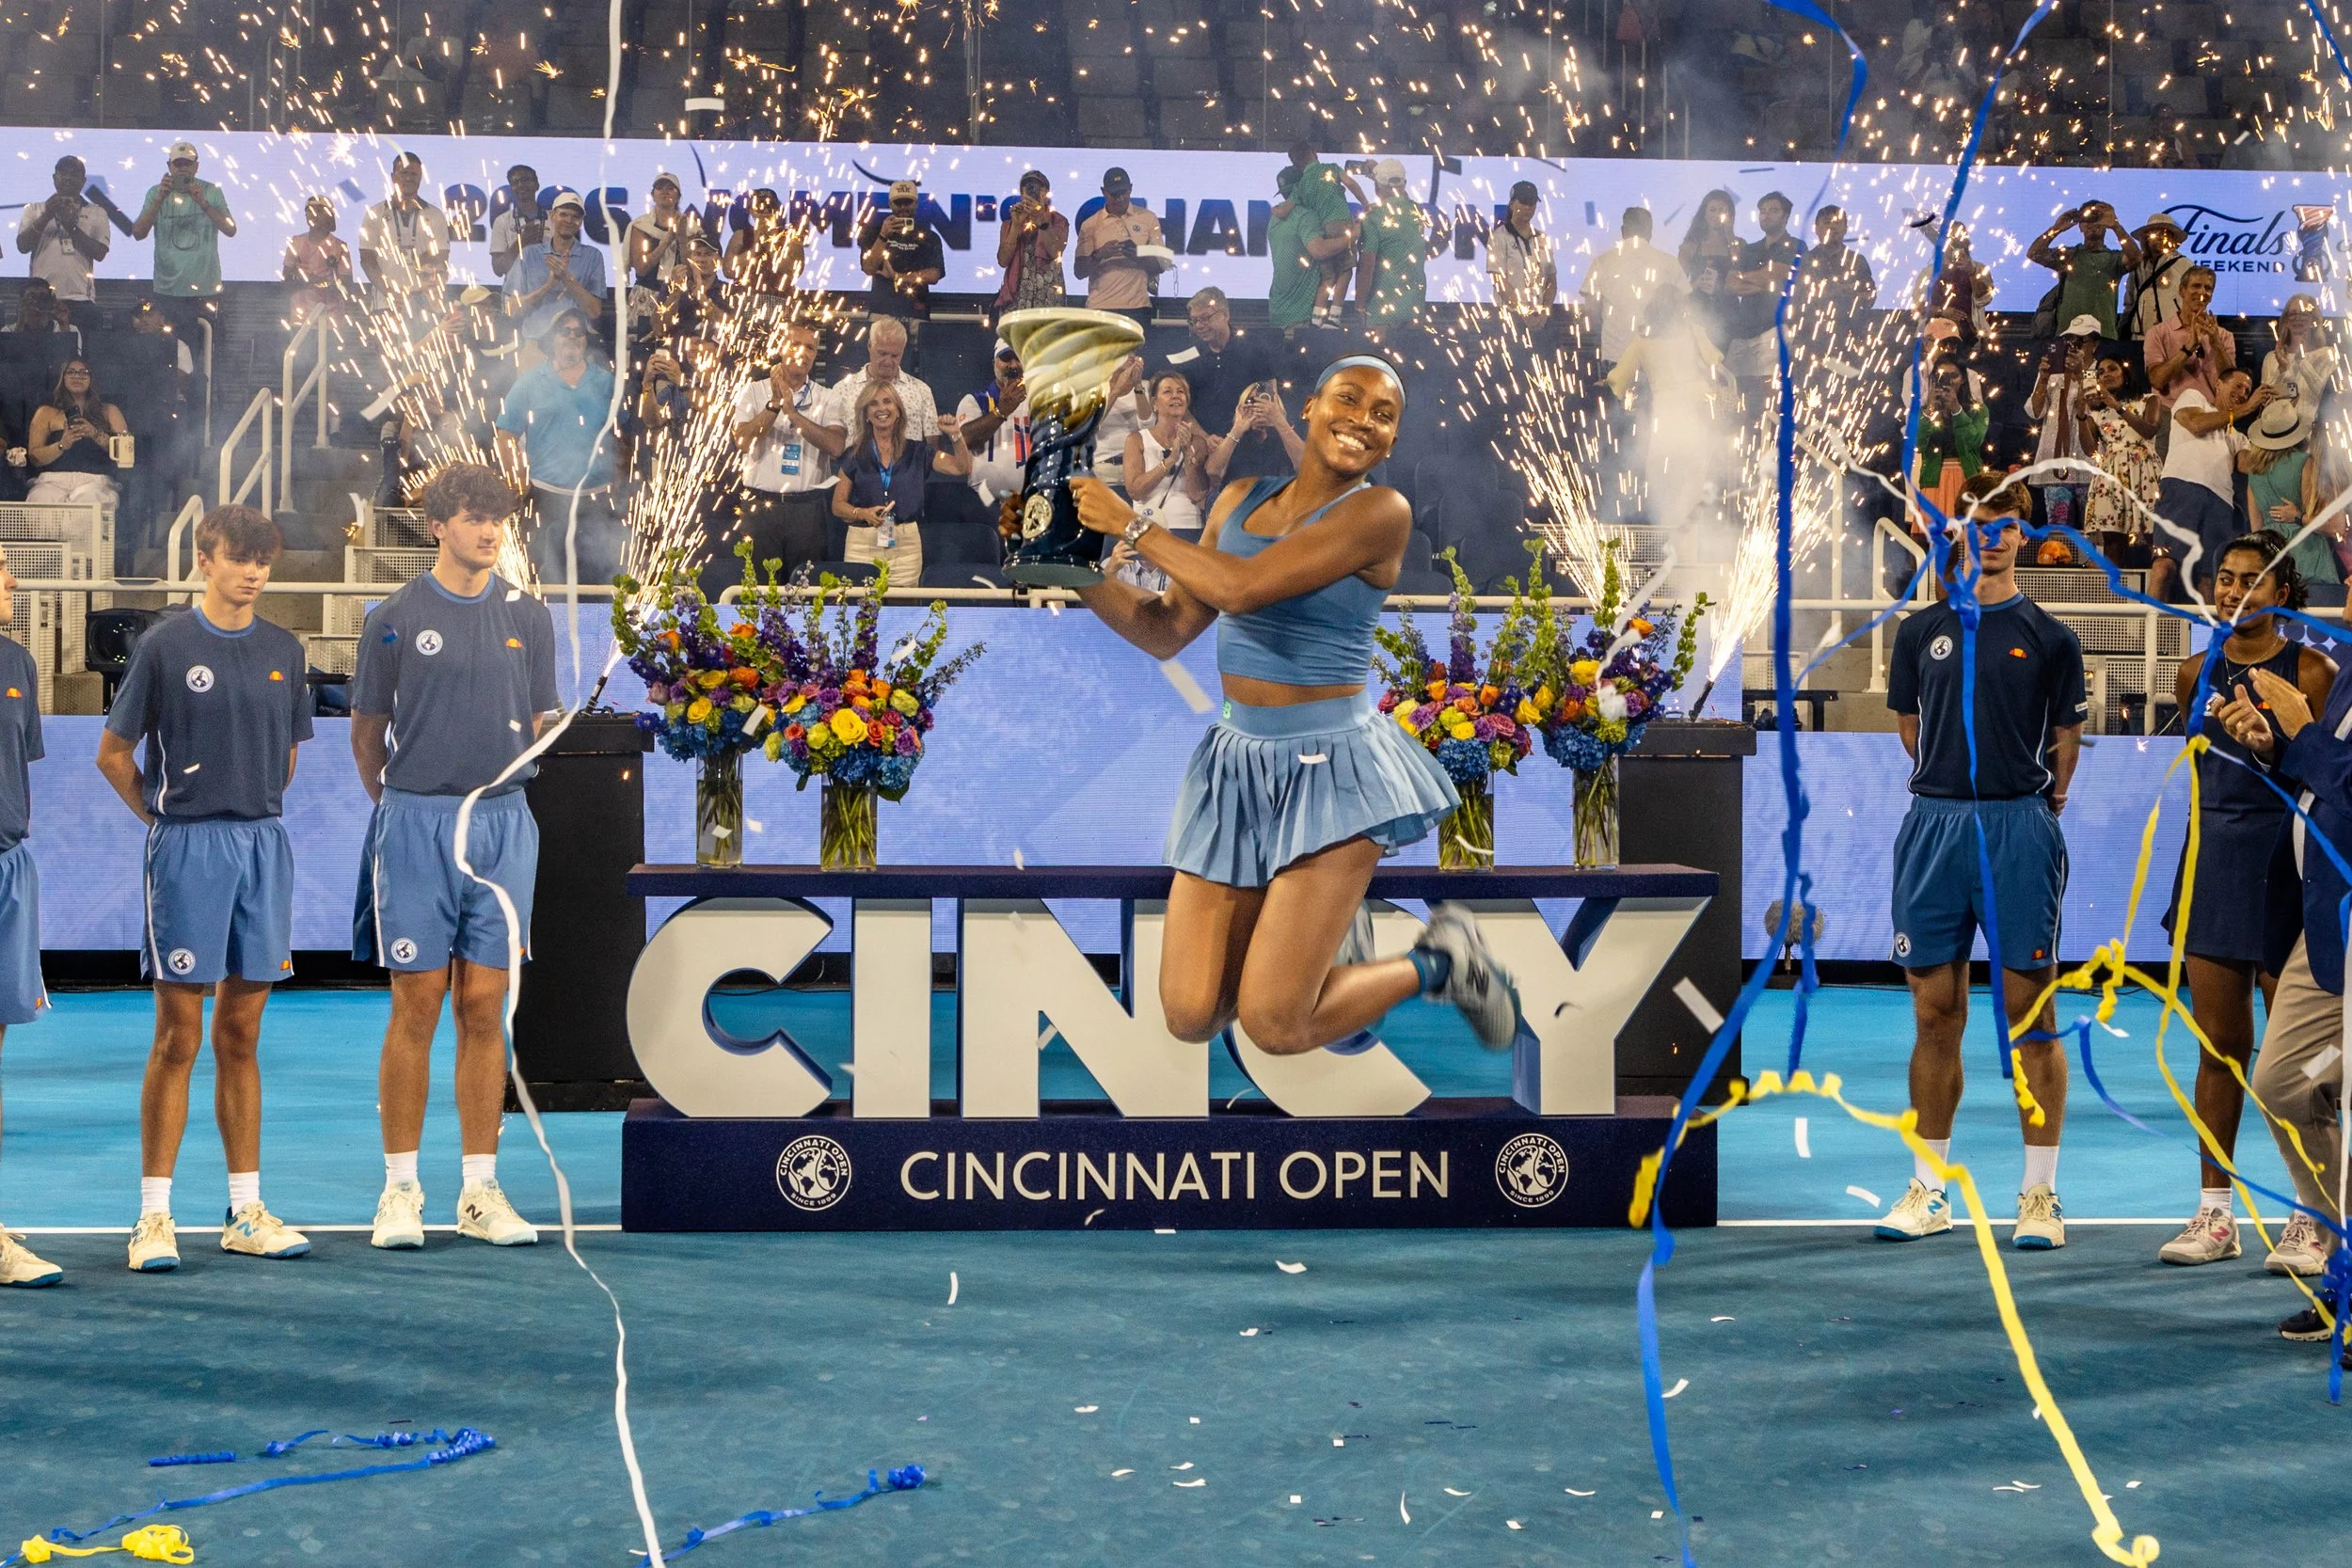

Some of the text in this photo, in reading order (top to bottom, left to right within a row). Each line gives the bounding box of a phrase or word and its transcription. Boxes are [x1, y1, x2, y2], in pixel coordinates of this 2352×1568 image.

[2162, 204, 2289, 256] Finals
[2194, 260, 2286, 273] EEKEND
[779, 1138, 849, 1177] CINCINNATI OPEN
[1499, 1136, 1565, 1174] CINCINNATI OPEN
[900, 1149, 1449, 1200] CINCINNATI OPEN
[790, 1192, 837, 1207] SINCE 1899
[1509, 1189, 1555, 1204] SINCE 1899
[465, 1203, 483, 1221] N
